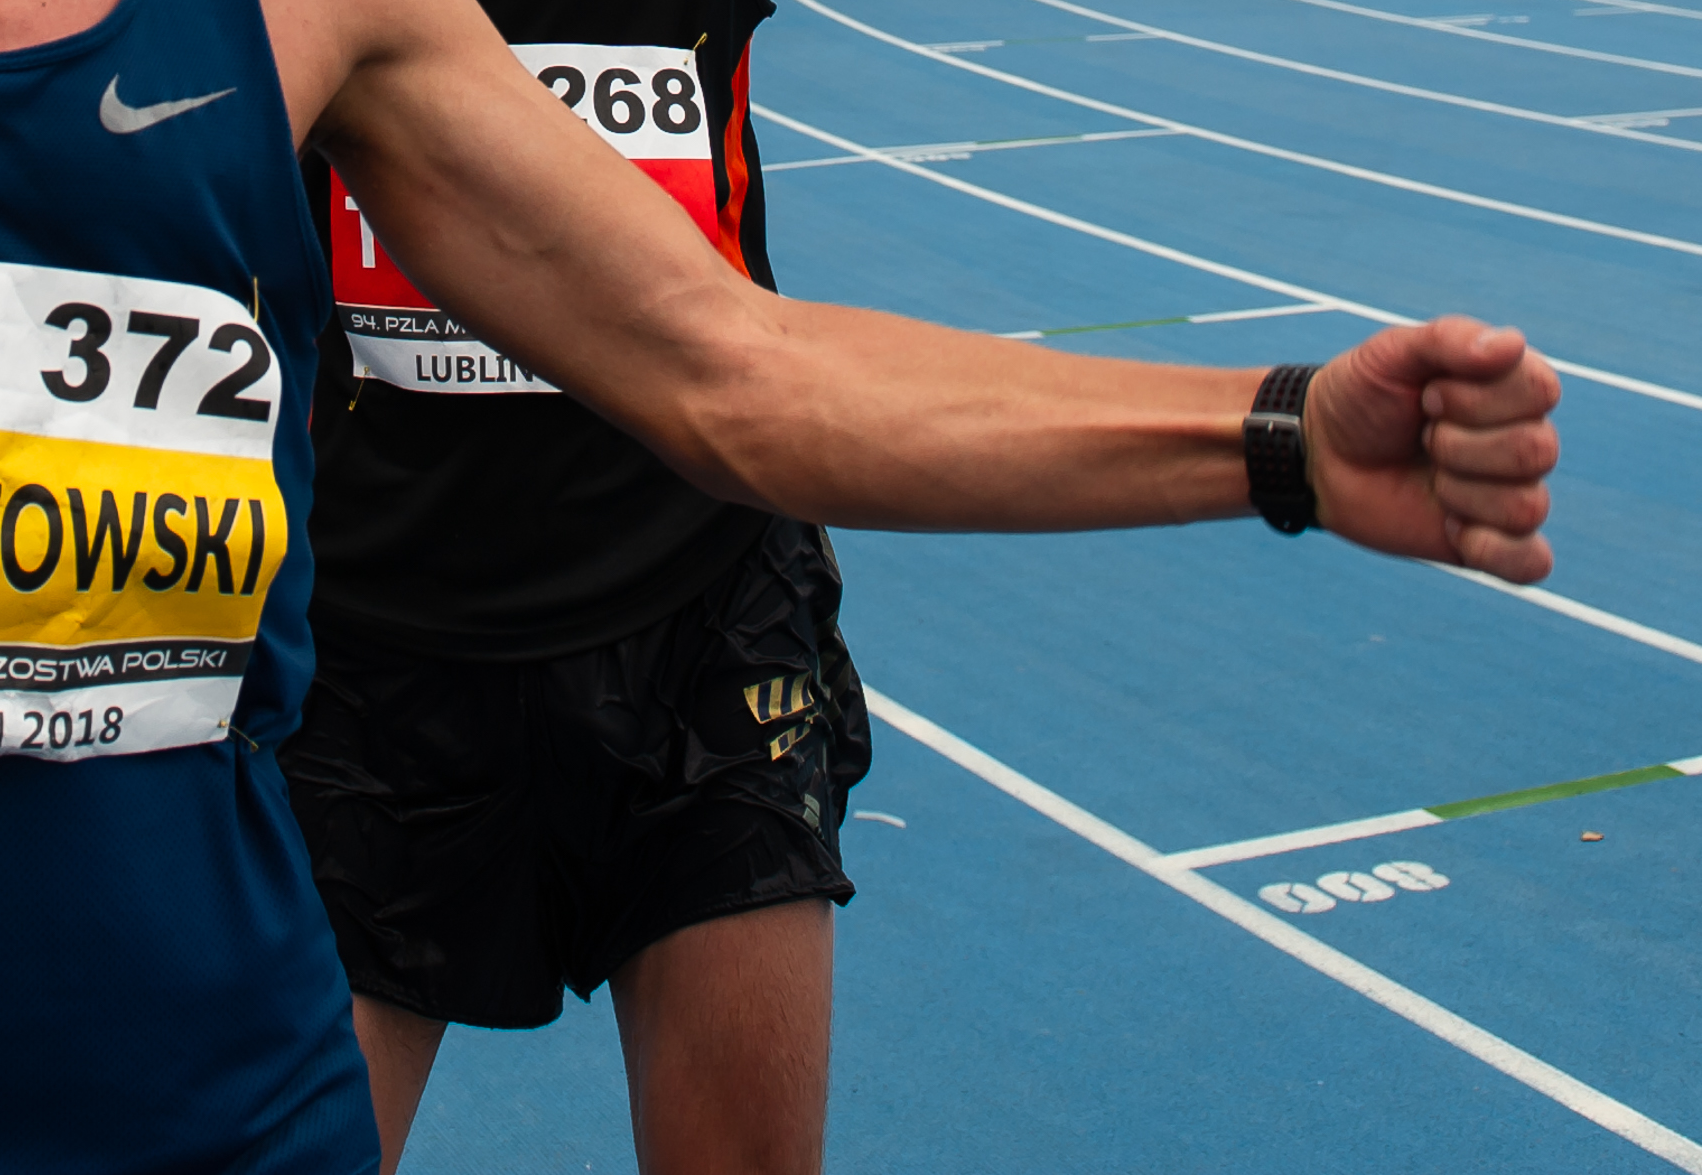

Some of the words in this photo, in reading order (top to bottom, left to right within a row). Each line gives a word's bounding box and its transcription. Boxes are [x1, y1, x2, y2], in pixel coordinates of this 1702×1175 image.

[537, 65, 702, 135] 268
[351, 313, 382, 332] 94.
[385, 316, 440, 334] PZLA
[39, 301, 273, 423] 372
[122, 648, 228, 674] POLSKI
[20, 705, 124, 750] 2018
